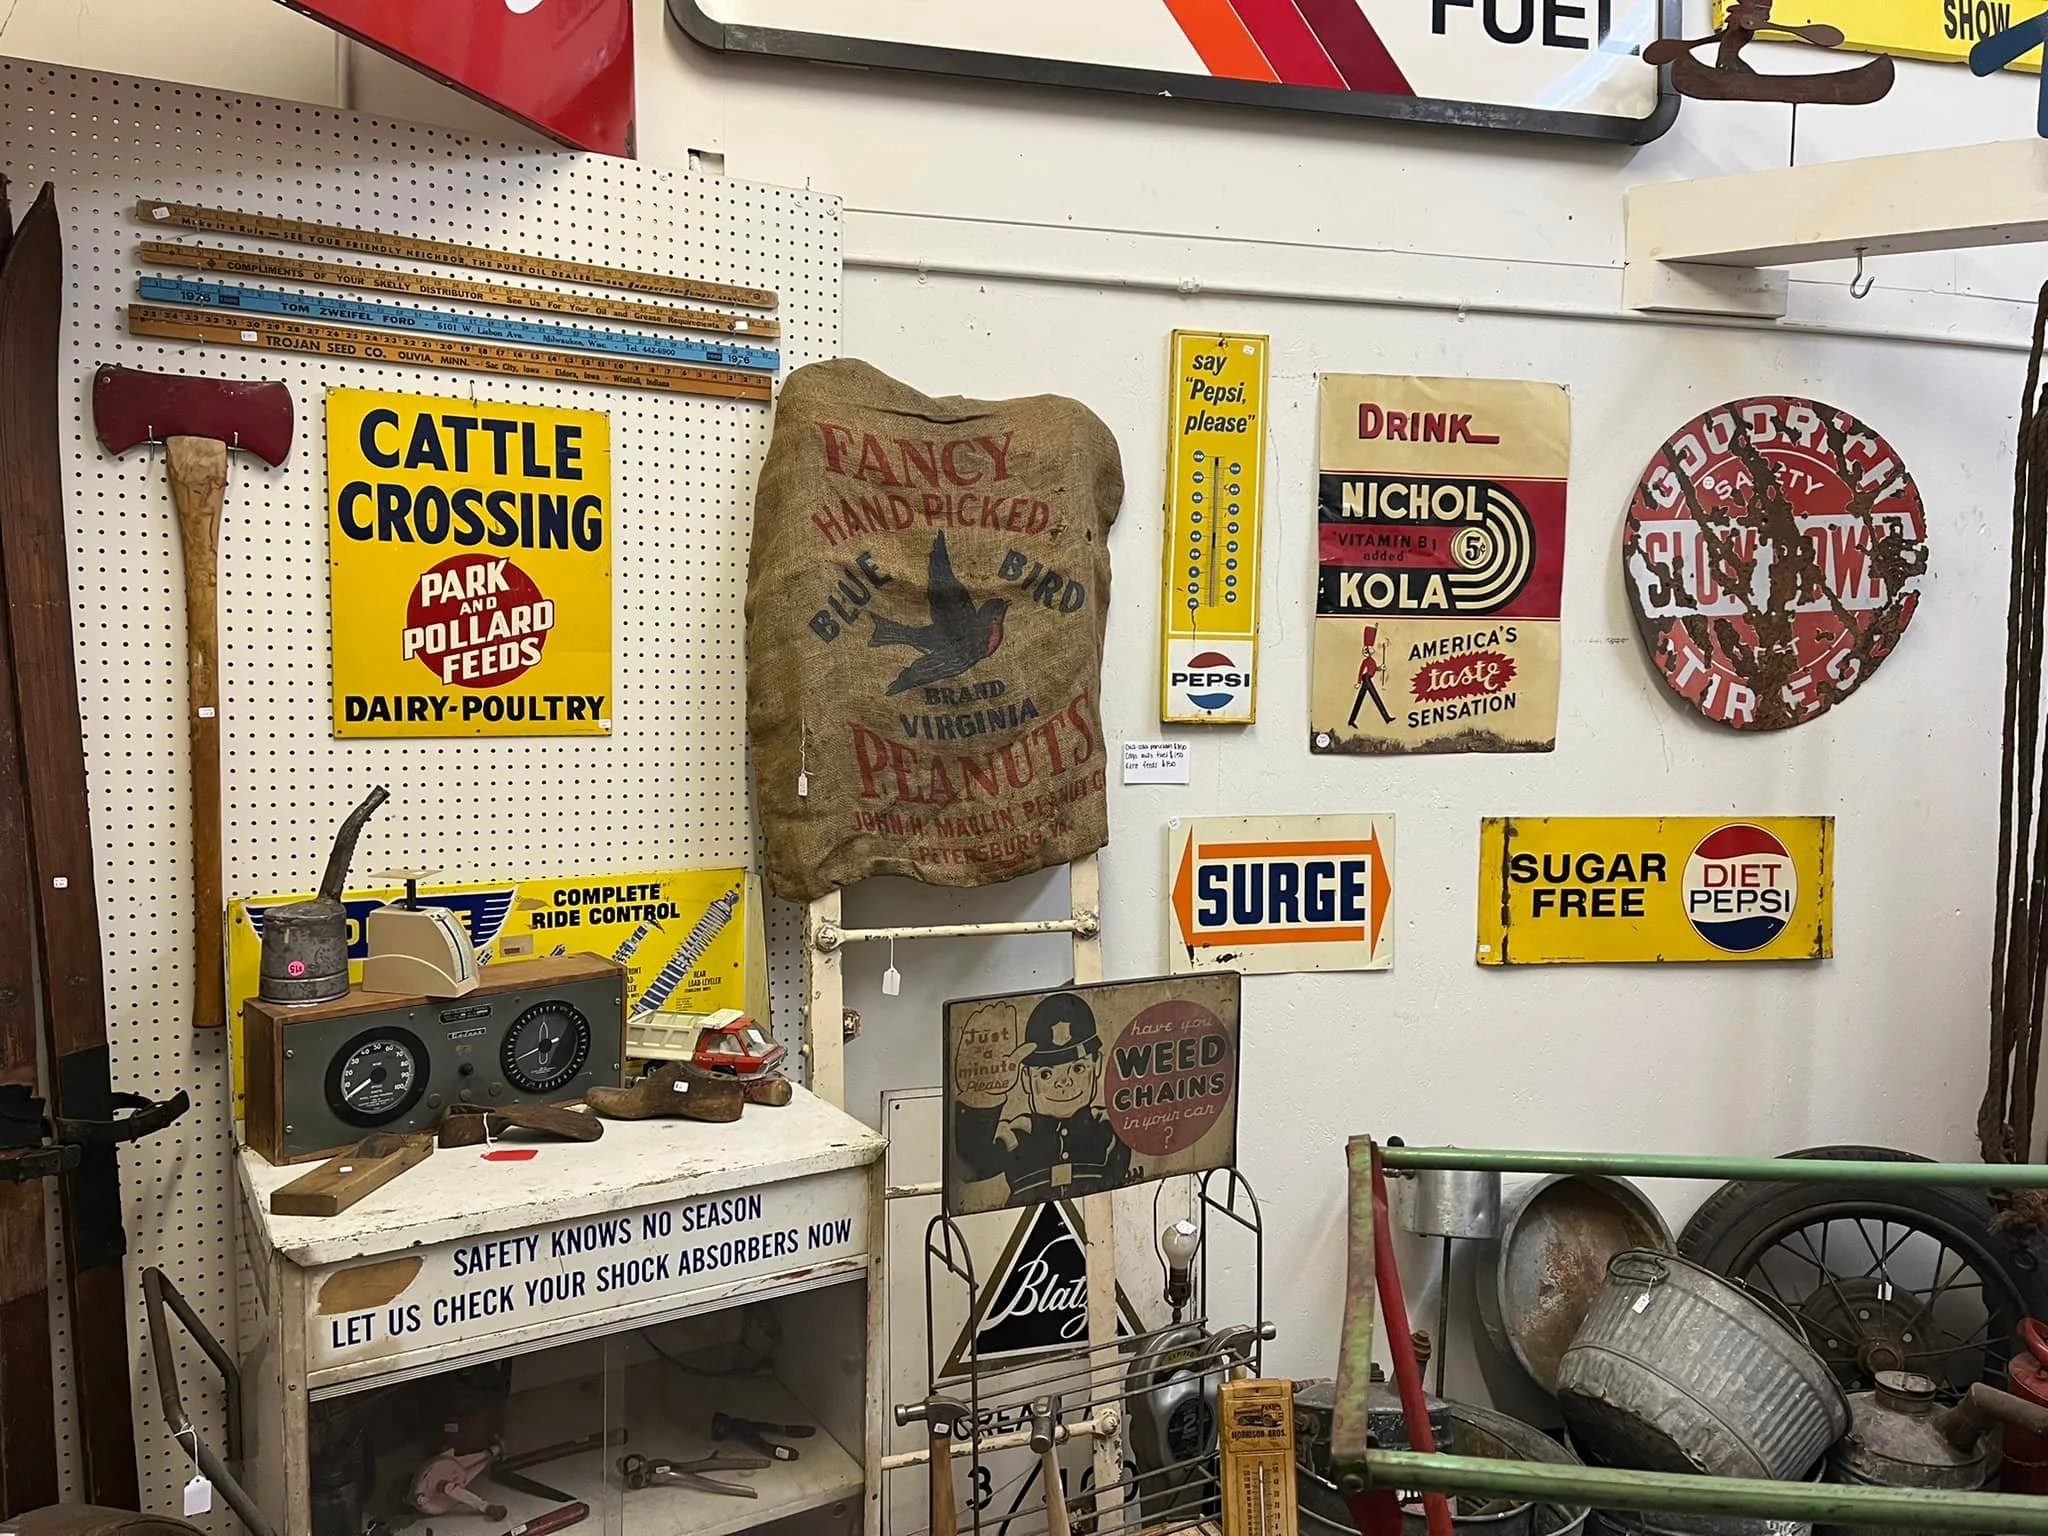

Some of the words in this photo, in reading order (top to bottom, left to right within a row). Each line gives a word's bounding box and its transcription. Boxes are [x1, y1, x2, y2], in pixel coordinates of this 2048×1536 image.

[1944, 0, 2010, 40] SHOW
[309, 235, 341, 246] YOUR
[346, 240, 400, 254] FRIENDLY
[406, 250, 464, 264] NEIGHBOR
[472, 258, 492, 268] THE
[497, 262, 526, 273] PURE
[529, 267, 546, 276] OIL
[552, 270, 591, 282] DEALER
[228, 262, 304, 278] COMPLIMENTS
[313, 272, 327, 280] OF
[337, 274, 365, 285] YOUR
[374, 279, 410, 290] SKELLY
[420, 285, 483, 300] DISTRIBUTOR
[506, 296, 522, 305] See
[530, 299, 540, 307] Us
[548, 302, 561, 310] For
[570, 304, 589, 312] Your
[596, 307, 606, 315] Oil
[614, 310, 627, 318] and
[668, 316, 720, 329] Requirements
[267, 323, 280, 331] 29
[306, 327, 319, 335] 27
[281, 302, 310, 313] TOM
[320, 308, 374, 321] ZWEIFEL
[383, 315, 415, 325] FORD
[438, 322, 457, 331] 6101
[462, 325, 473, 333] W.
[266, 336, 320, 351] TROJAN
[327, 343, 356, 355] SEED
[365, 348, 386, 359] CO.
[399, 351, 434, 363] OLIVIA,
[440, 356, 470, 366] MINN.
[485, 362, 499, 370] Sac
[502, 363, 519, 373] City,
[523, 366, 540, 374] Iowa
[584, 372, 600, 381] Iowa
[646, 377, 670, 387] Indiana
[1192, 354, 1228, 376] say
[1358, 403, 1500, 445] DRINK
[359, 408, 582, 481] CATTLE
[818, 422, 1014, 488] FANCY
[1714, 460, 1825, 501] SAETY
[337, 481, 602, 552] CROSSING
[1341, 482, 1483, 522] NICHOL
[420, 557, 510, 608] PARK
[808, 551, 892, 642] BLUE
[997, 548, 1086, 614] BIRD
[1340, 572, 1449, 609] KOLA
[460, 596, 497, 615] AND
[403, 600, 554, 660] POLLARD
[1408, 625, 1518, 662] AMERICA'S
[443, 637, 542, 684] FEEDS
[1426, 660, 1500, 692] taste
[924, 679, 1005, 706] BRAND
[1172, 672, 1250, 687] PEPSI
[1674, 646, 1862, 722] TIRES
[345, 695, 605, 722] DAIRY-POULTRY
[900, 697, 1039, 740] VIRGINIA
[1407, 692, 1516, 728] SENSATION
[848, 686, 1095, 806] PEANUTS
[853, 810, 904, 835] JOHN
[918, 830, 1043, 864] PETERSBURG
[1510, 853, 1667, 884] SUGAR
[1704, 863, 1782, 889] DIET
[553, 883, 660, 907] COMPLETE
[1198, 860, 1366, 927] SURGE
[1532, 888, 1646, 919] FREE
[1689, 889, 1791, 914] PEPSI
[532, 911, 581, 929] RIDE
[589, 902, 680, 925] CONTROL
[964, 1028, 1009, 1046] Just
[1130, 1020, 1173, 1036] have
[1181, 1017, 1212, 1033] you
[959, 1060, 1016, 1079] minute
[983, 1049, 993, 1059] a
[1114, 1034, 1226, 1080] WEED
[1112, 1072, 1225, 1112] CHAINS
[1142, 1110, 1180, 1130] your
[1184, 1104, 1215, 1118] car
[1164, 1126, 1174, 1149] ?
[453, 1234, 539, 1277] SAFETY
[551, 1218, 632, 1258] KNOWS
[642, 1210, 672, 1241] NO
[682, 1193, 762, 1232] SEASON
[332, 1312, 376, 1349] LET
[389, 1304, 421, 1336] US
[433, 1284, 515, 1326] CHECK
[525, 1270, 586, 1307] YOUR
[596, 1254, 670, 1292] SHOCK
[678, 1228, 799, 1276] ABSORBERS
[808, 1218, 852, 1249] NOW
